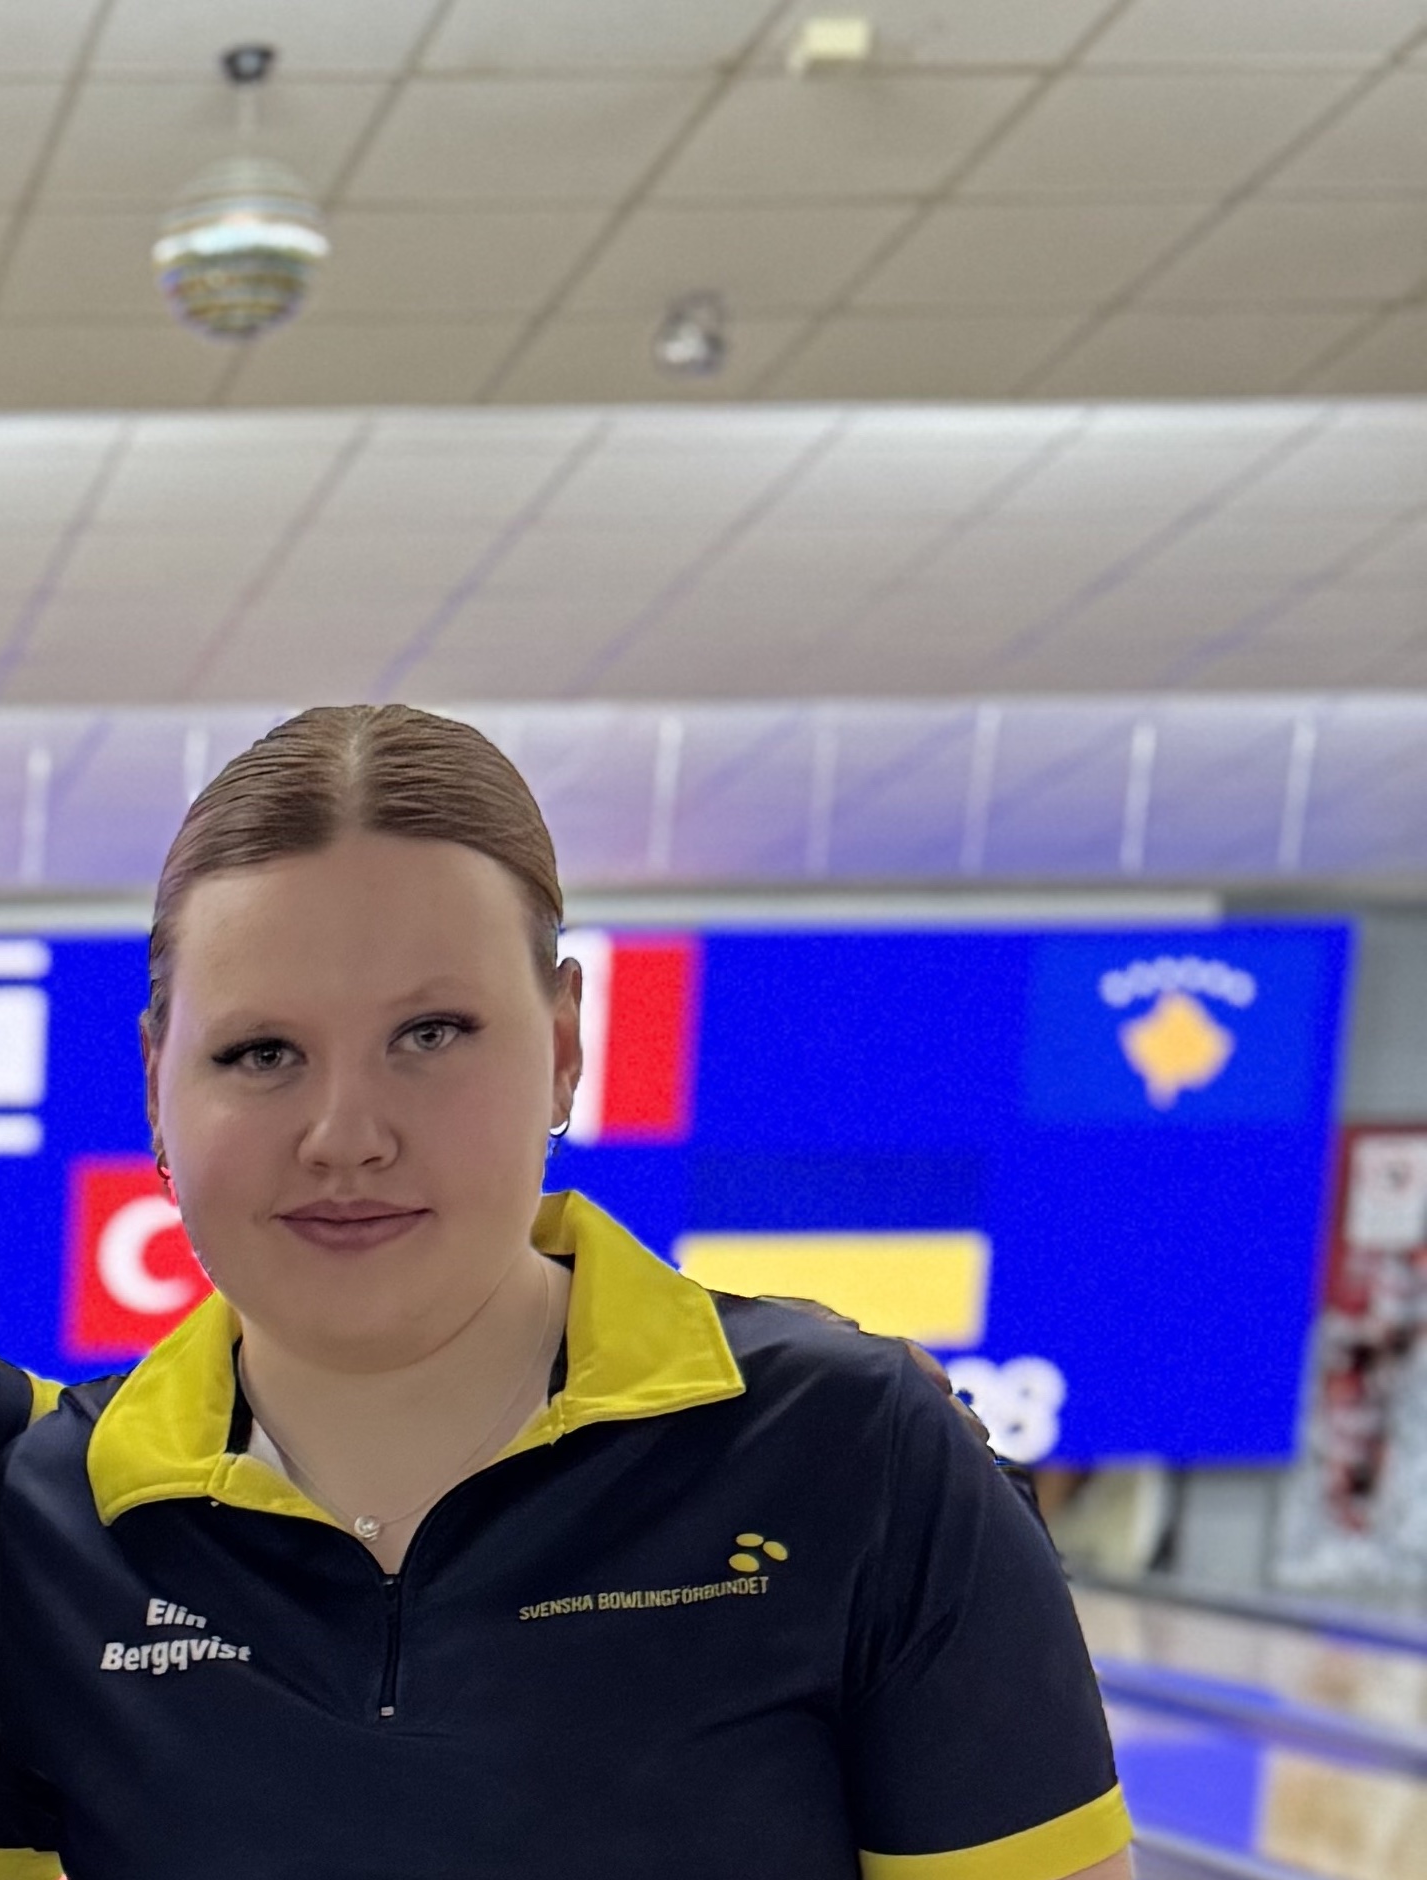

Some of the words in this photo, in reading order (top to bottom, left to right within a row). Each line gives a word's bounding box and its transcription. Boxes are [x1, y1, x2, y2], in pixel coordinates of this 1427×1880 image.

[146, 1598, 207, 1629] Elin
[519, 1594, 594, 1621] SVENSKA
[100, 1635, 252, 1675] Bergqvist
